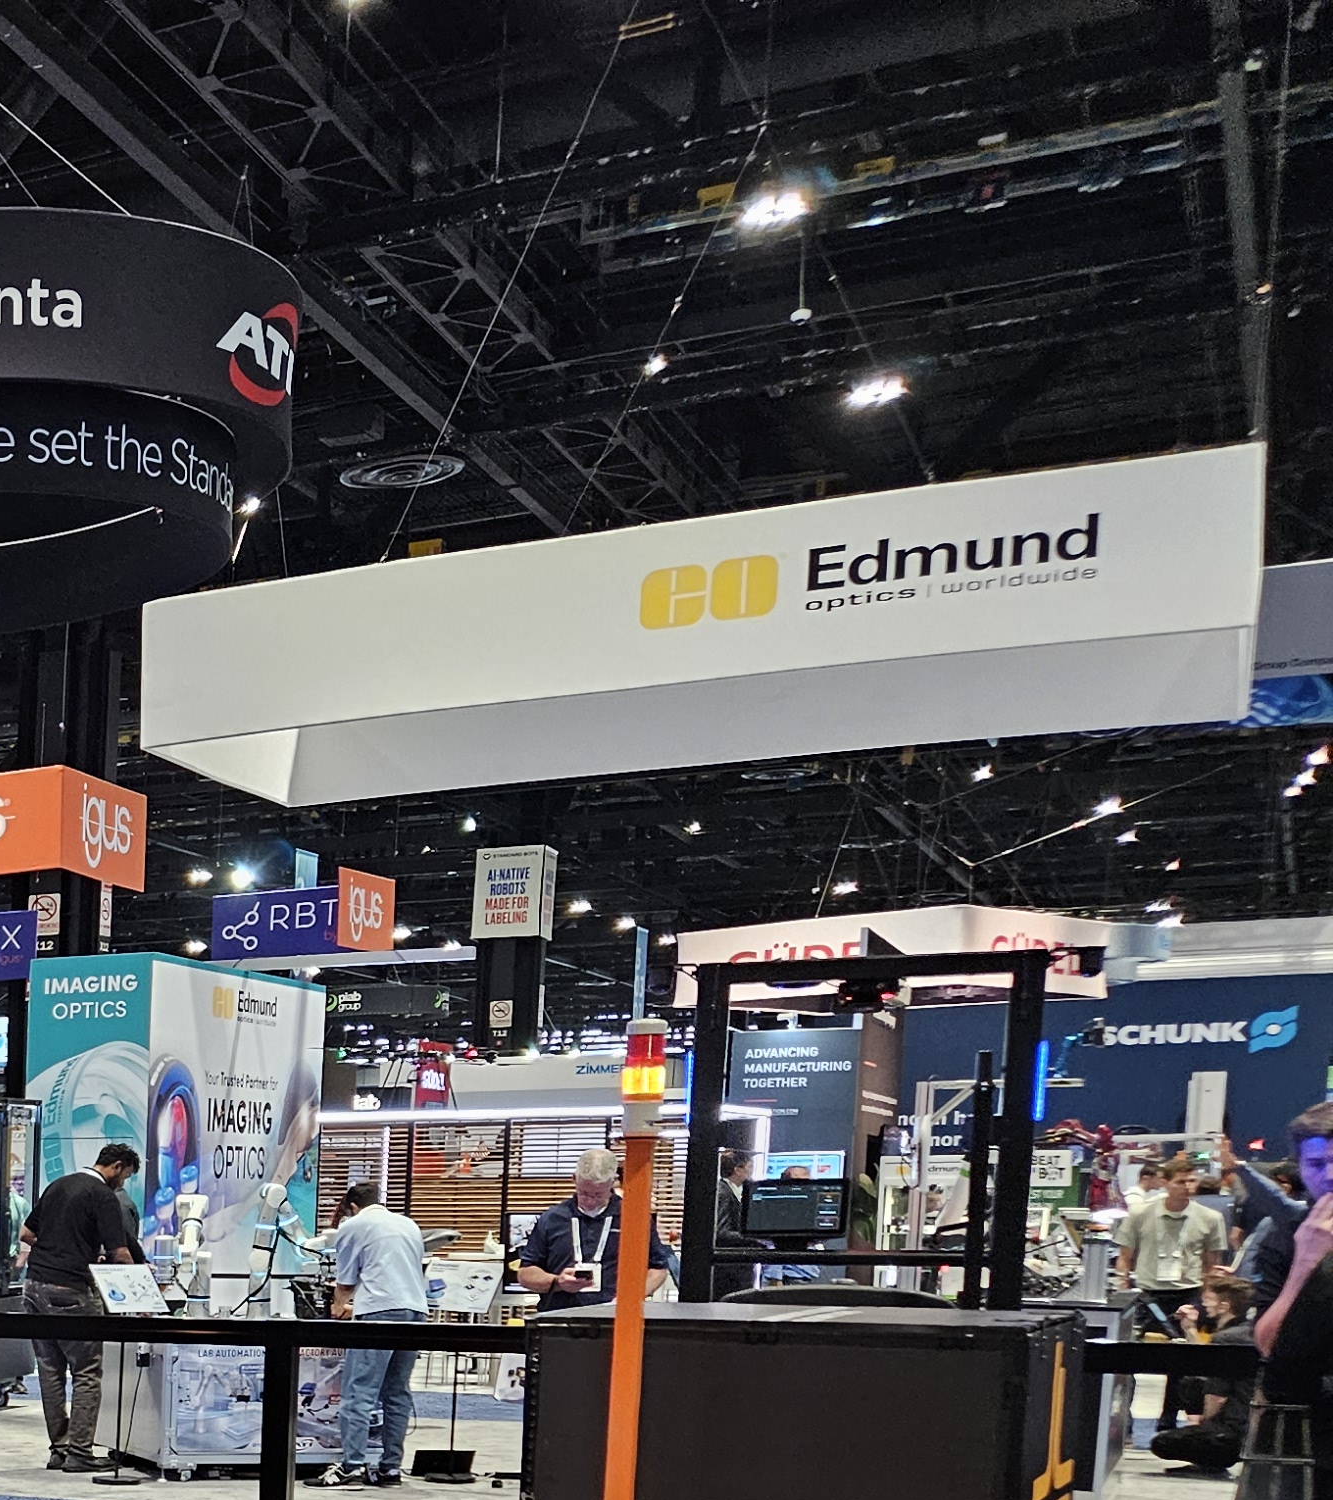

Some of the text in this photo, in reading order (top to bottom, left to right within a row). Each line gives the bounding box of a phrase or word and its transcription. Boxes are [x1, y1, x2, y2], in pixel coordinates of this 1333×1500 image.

[216, 311, 295, 397] ATI
[27, 419, 93, 466] set
[104, 422, 161, 478] the
[805, 513, 1100, 592] Edmund
[805, 567, 1099, 612] optics worldwide
[83, 782, 133, 868] igus
[487, 867, 531, 882] AI-NATIVE
[490, 881, 526, 897] ROBOTS
[349, 877, 383, 942] igus
[485, 896, 529, 911] MADE FOR
[270, 898, 338, 932] RBT
[485, 911, 528, 926] LABELING
[44, 974, 139, 995] IMAGING
[52, 1000, 128, 1021] OPTICS
[238, 990, 277, 1018] Edmund
[492, 1029, 508, 1038] T12
[1104, 1021, 1248, 1046] SCHUNK
[745, 1046, 819, 1060] ADVANCING
[744, 1060, 852, 1074] MANUFACTURING
[205, 1070, 219, 1085] Your
[220, 1072, 244, 1088] Trusted
[245, 1074, 267, 1089] Partner
[743, 1076, 808, 1089] TOGETHER
[207, 1097, 273, 1135] IMAGING
[213, 1144, 266, 1180] OPTICS
[198, 1348, 214, 1358] LAB
